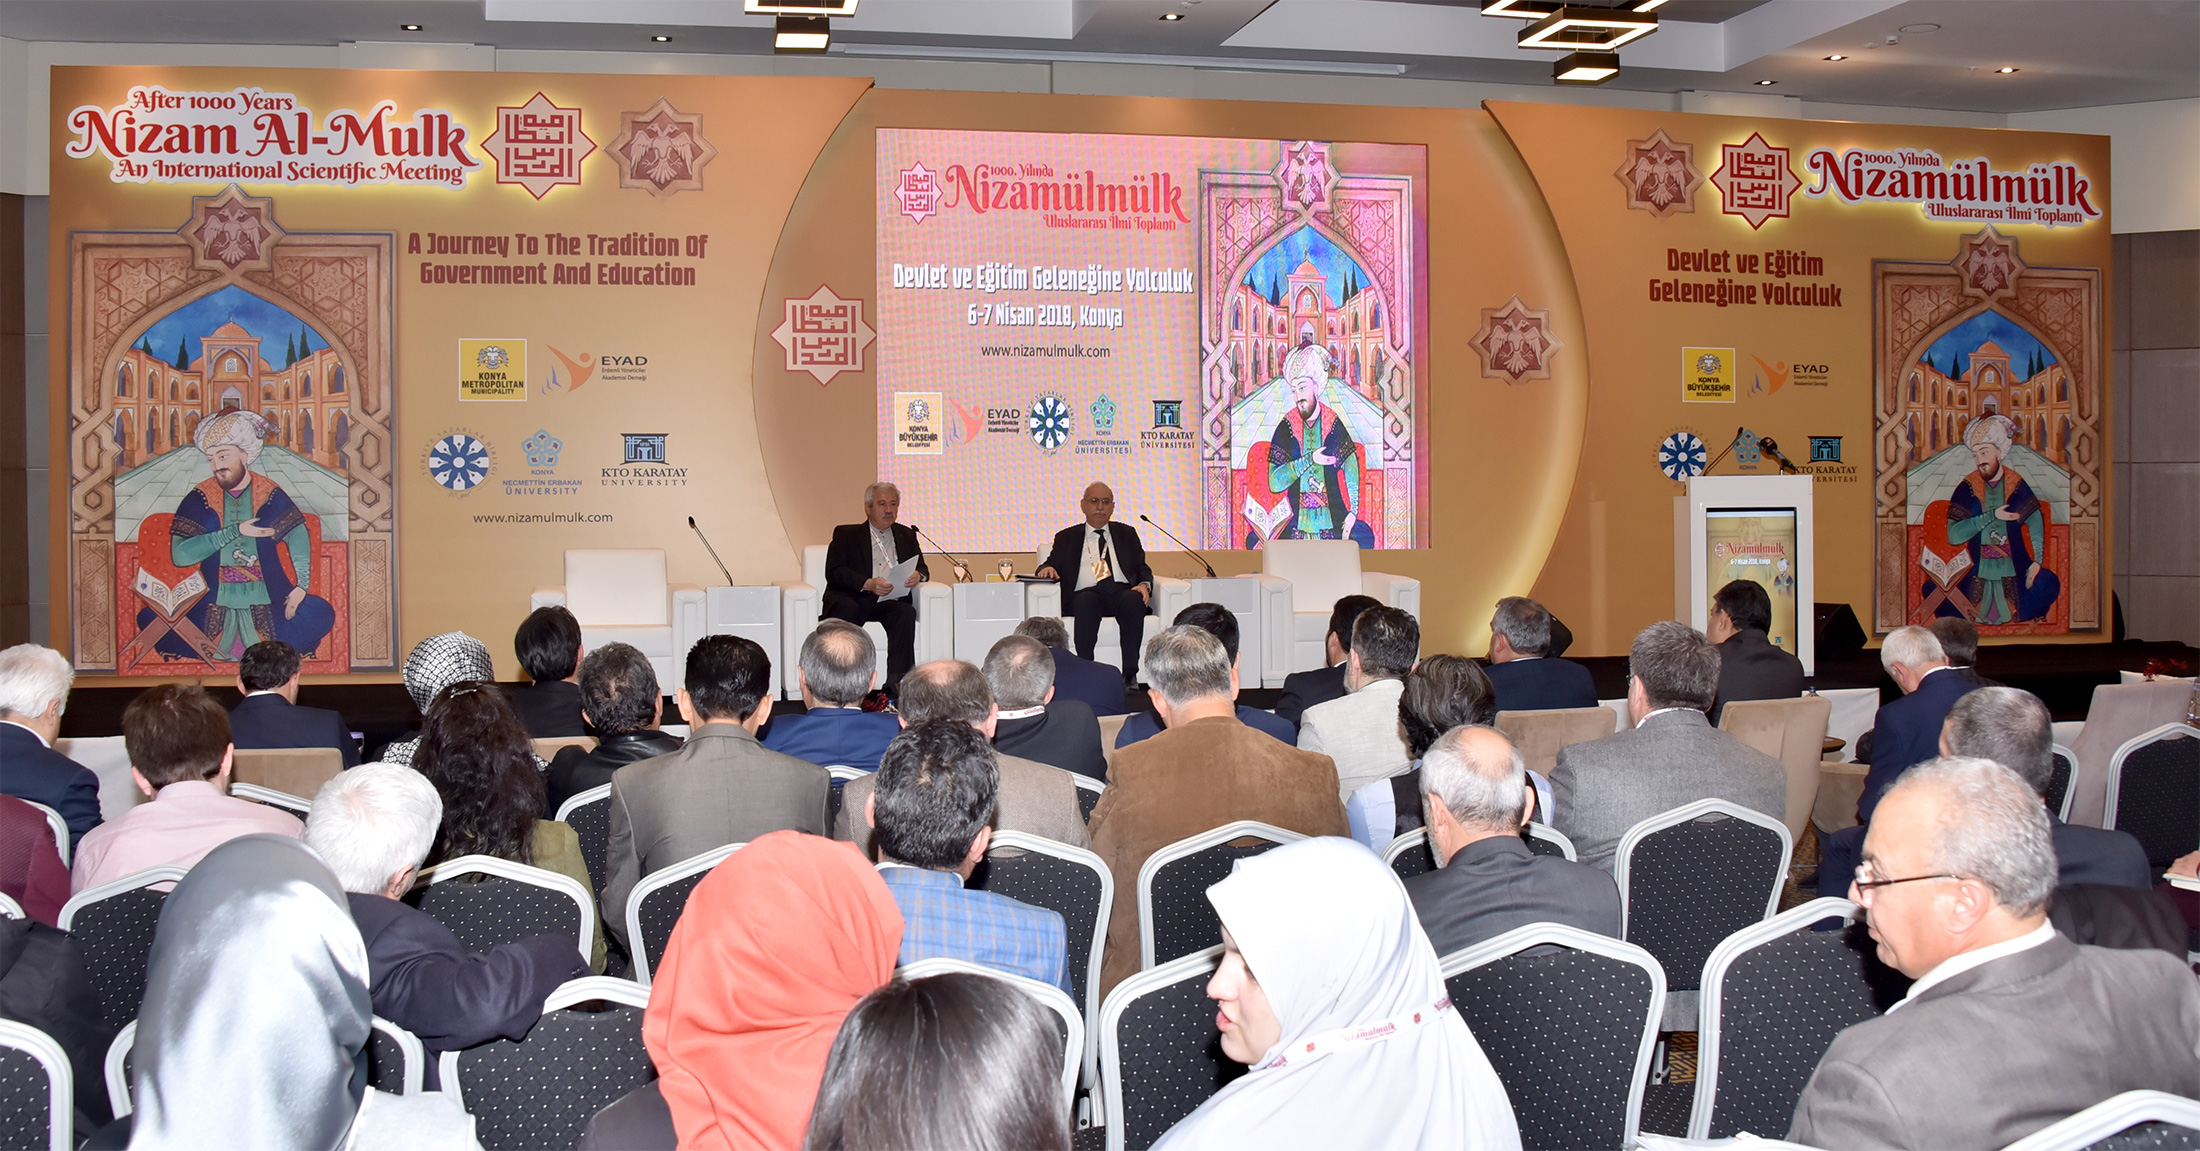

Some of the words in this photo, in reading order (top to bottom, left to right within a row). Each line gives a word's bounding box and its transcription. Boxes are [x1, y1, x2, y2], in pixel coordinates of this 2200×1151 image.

[130, 90, 185, 113] After
[190, 96, 236, 110] 1000
[238, 92, 293, 115] Years
[71, 109, 240, 158] Nizam
[245, 105, 480, 167] Al-Mulk
[1864, 153, 1896, 165] 1000.
[1898, 151, 1940, 169] Yılında
[116, 159, 148, 178] An
[152, 159, 282, 180] International
[287, 158, 376, 184] Scientific
[380, 159, 463, 186] Meeting
[991, 166, 1017, 176] 1000.
[1809, 151, 2100, 216] Nizamülmülk
[944, 164, 1191, 223] Nizamülmülk
[1928, 202, 2003, 219] Uluslararası
[2034, 207, 2083, 225] Toplantı
[1043, 214, 1107, 229] Uluslararası
[1134, 216, 1176, 233] Toplantı
[408, 233, 421, 254] A
[427, 233, 509, 258] Journey
[515, 233, 538, 255] To
[545, 233, 581, 255] The
[587, 232, 679, 256] Tradition
[686, 234, 708, 259] Of
[1667, 248, 1731, 273] Devlet
[1736, 254, 1759, 274] ve
[1765, 250, 1823, 278] Eğitim
[420, 262, 547, 285] Government
[553, 262, 591, 285] And
[597, 262, 695, 286] Education
[893, 262, 948, 289] Devlet
[952, 267, 972, 289] ve
[977, 262, 1028, 293] Eğitim
[1032, 264, 1122, 295] Geleneğine
[1126, 267, 1194, 294] Yolculuk
[1650, 278, 1757, 307] Geleneğine
[1762, 282, 1842, 307] Yolculuk
[967, 303, 993, 326] 6-7
[996, 302, 1035, 327] Nisan
[1038, 304, 1077, 330] 2018,
[1080, 304, 1124, 331] Konya
[981, 344, 1110, 358] www.nizamulmulk.com
[602, 356, 648, 366] EYAD
[1793, 364, 1829, 374] EYAD
[462, 381, 524, 389] METROPOLITAN
[478, 372, 507, 381] KONYA
[1687, 383, 1731, 392] BÜYÜKŞEHİR
[988, 408, 1020, 419] EYAD
[1140, 431, 1158, 440] KTO
[1160, 431, 1195, 440] KARATAY
[601, 468, 630, 477] KTO
[633, 468, 688, 477] KARATAY
[1794, 466, 1814, 474] KTO
[1816, 466, 1857, 474] KARATAY
[473, 512, 613, 524] www.nizamulmulk.com
